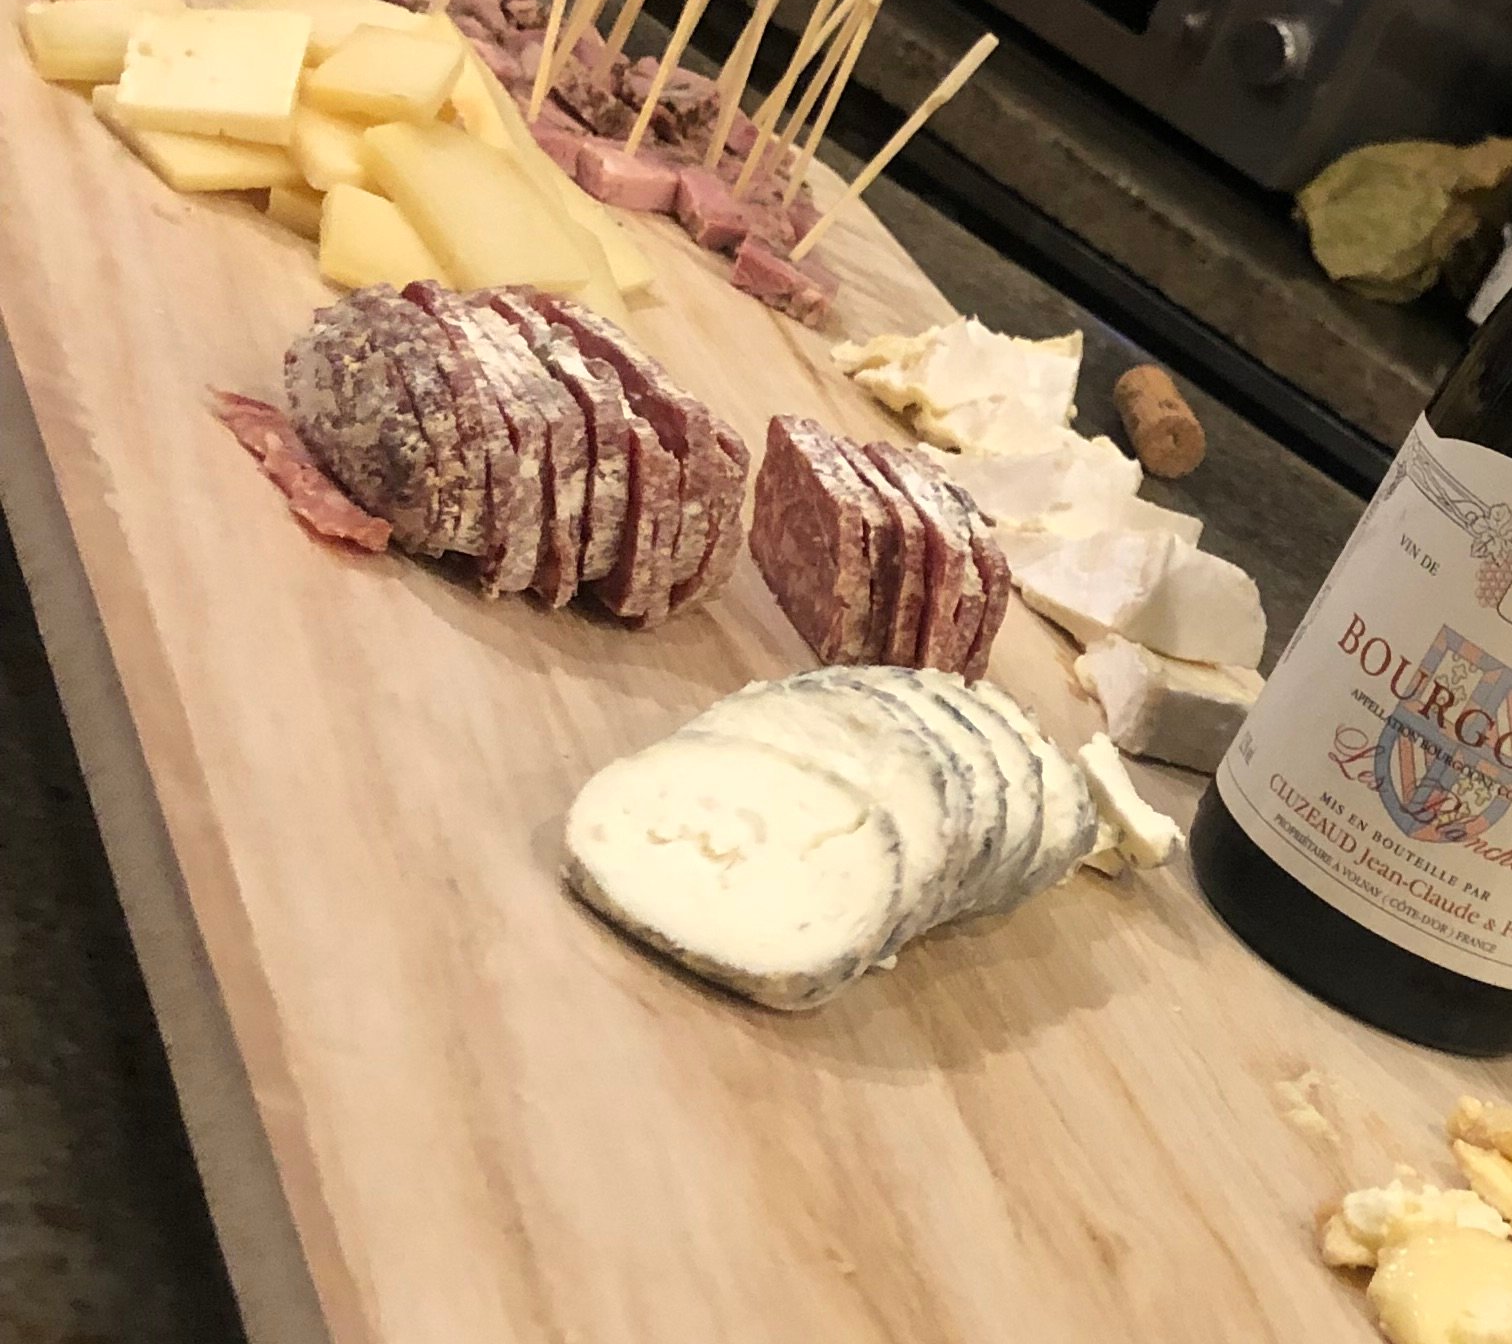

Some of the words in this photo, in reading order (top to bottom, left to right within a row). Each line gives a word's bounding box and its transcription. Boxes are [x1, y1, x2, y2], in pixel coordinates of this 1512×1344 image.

[1400, 533, 1422, 560] VIN
[1420, 555, 1441, 577] DE
[1351, 688, 1422, 741] APPELLATION
[1419, 737, 1495, 790] BOURGOGNE
[1269, 773, 1358, 854] CLUZEAUD
[1353, 848, 1481, 925] Jean-Claude
[1483, 918, 1496, 932] &
[1320, 792, 1345, 815] MIS
[1347, 813, 1369, 832] EN
[1371, 830, 1459, 887] BOUTEILLE
[1463, 882, 1491, 902] PAR
[1342, 866, 1382, 898] VOLNAY
[1455, 931, 1498, 955] FRANCE
